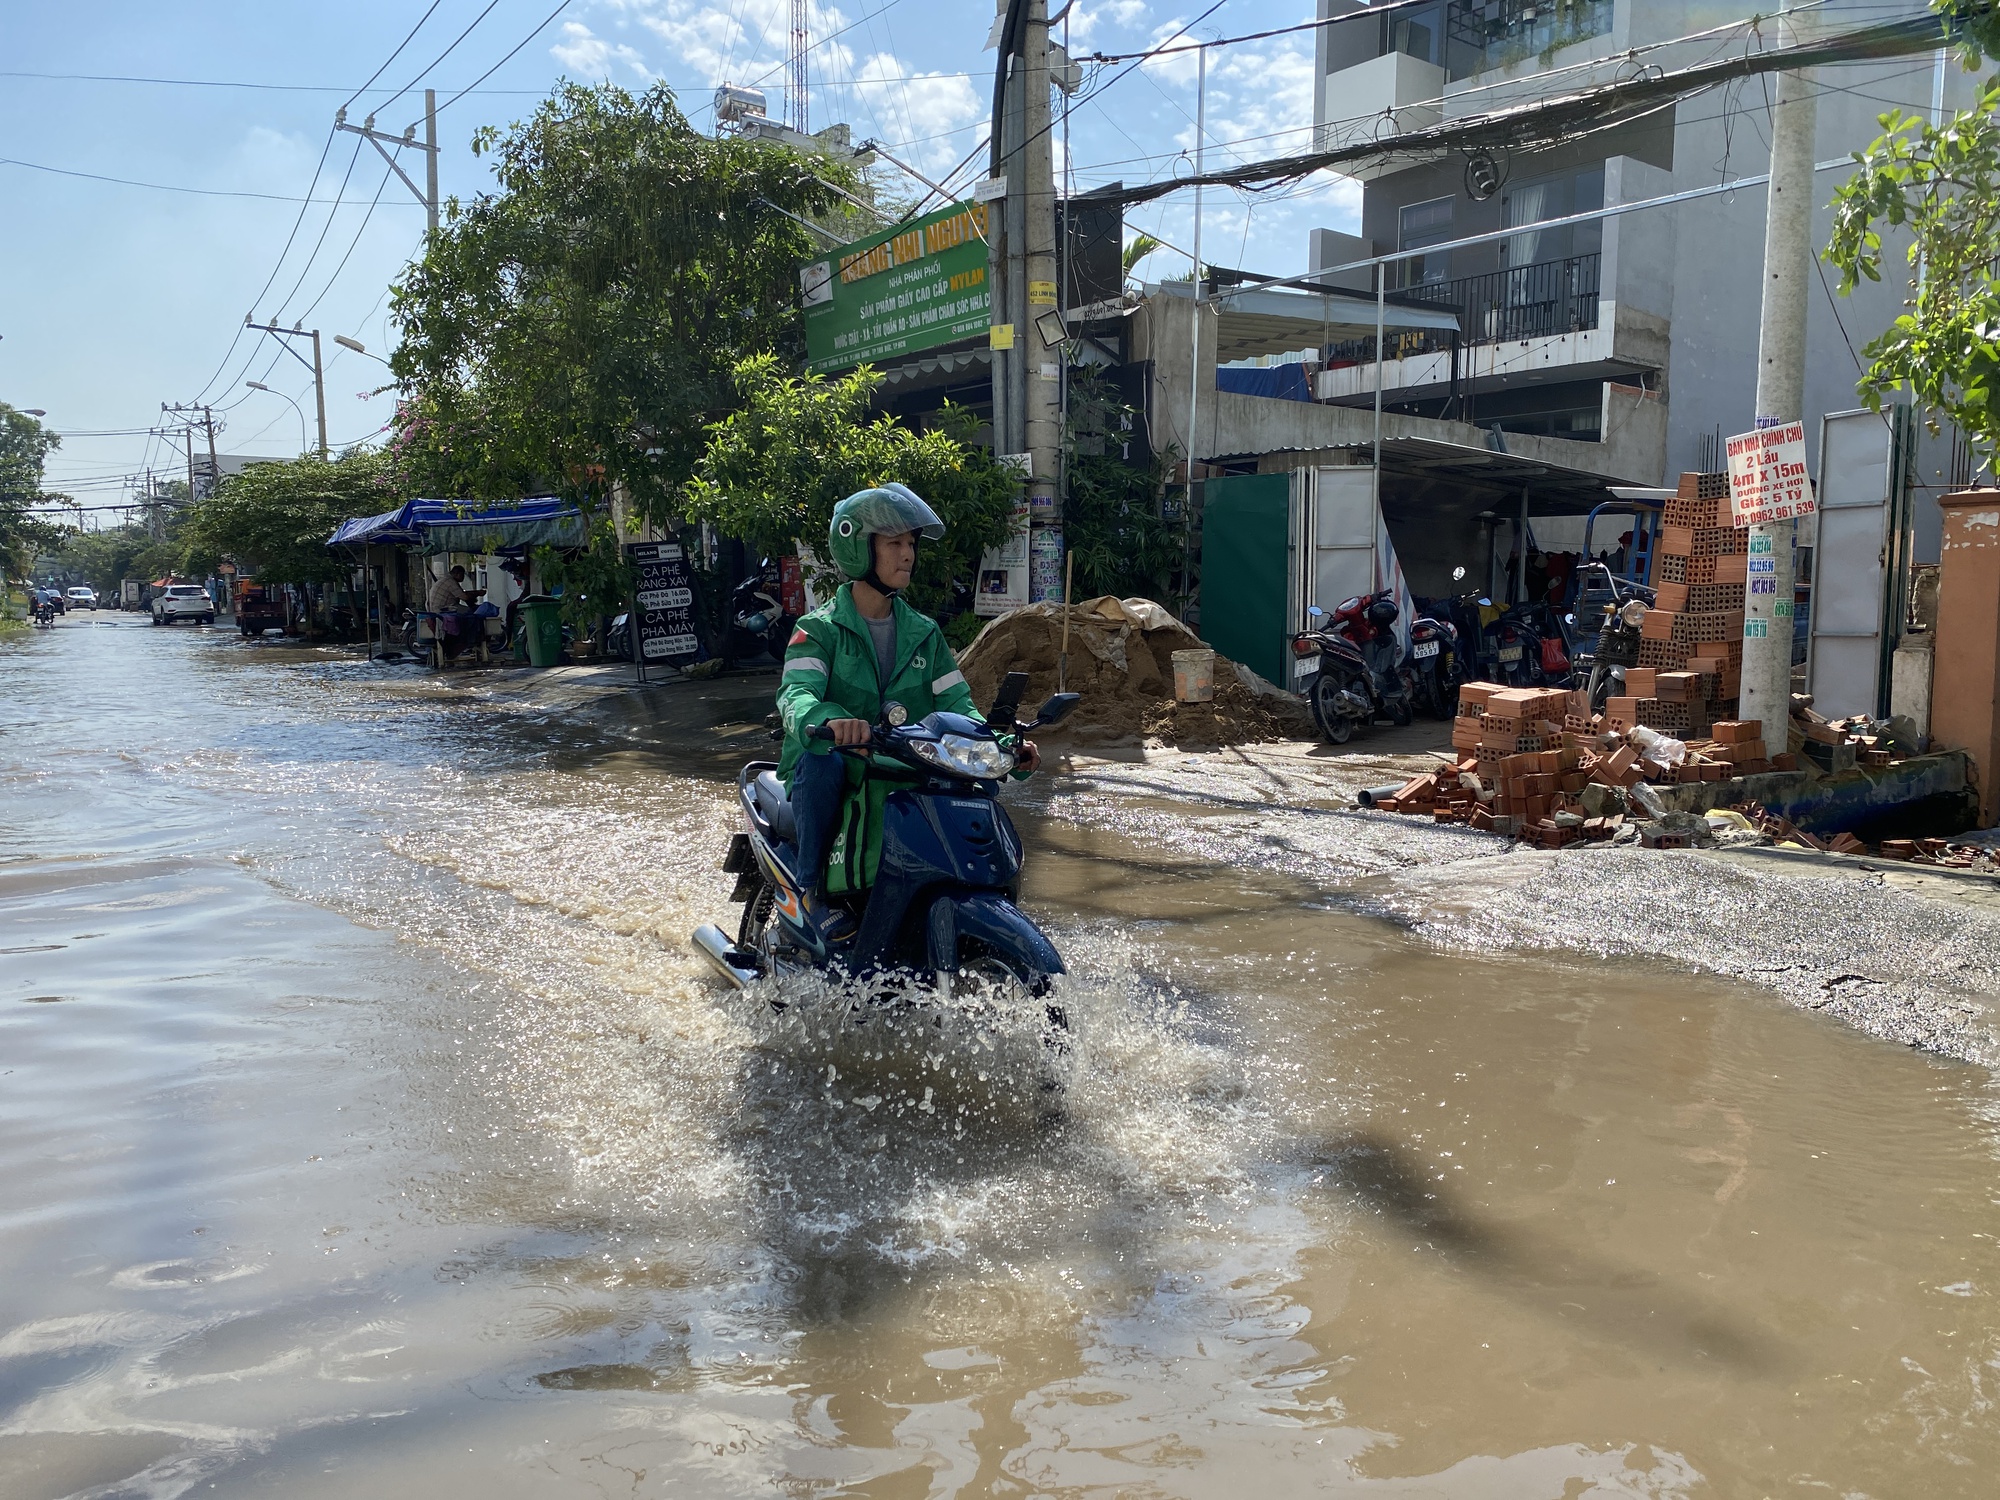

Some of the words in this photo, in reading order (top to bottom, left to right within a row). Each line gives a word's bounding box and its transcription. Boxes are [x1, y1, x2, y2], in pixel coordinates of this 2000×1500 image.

[892, 230, 923, 266] NHI
[889, 272, 902, 288] NHÀ
[904, 267, 923, 284] PHÂN
[924, 260, 941, 278] PHỐI
[861, 300, 874, 319] SẢN
[876, 293, 897, 315] PHẨM
[897, 288, 914, 309] GIẤY
[915, 285, 931, 302] CAO
[933, 276, 949, 297] CẤP
[950, 267, 985, 292] MYLAN
[908, 310, 920, 329] SẢN
[922, 303, 938, 325] PHẨM
[957, 296, 969, 315] SÓC
[970, 292, 983, 311] NHÀ
[1728, 438, 1744, 457] BÁN
[1744, 433, 1760, 453] NHÀ
[1761, 429, 1785, 448] CHÍNH
[1786, 421, 1803, 443] CHỦ
[1746, 456, 1754, 469] 2
[1757, 450, 1779, 466] Lầu
[1733, 473, 1755, 488] 4m
[1760, 470, 1769, 482] x
[1773, 462, 1804, 479] 15m
[1772, 481, 1785, 490] XE
[1786, 477, 1804, 487] HƠI
[1740, 495, 1769, 509] Giá:
[1772, 492, 1783, 503] 5
[1785, 487, 1802, 500] Tỷ
[1735, 513, 1748, 526] ĐT:
[1750, 508, 1774, 523] 0962
[1776, 505, 1793, 519] 961
[1796, 500, 1815, 515] 539
[643, 565, 660, 578] CÀ
[661, 563, 681, 576] PHÊ
[669, 575, 689, 587] XAY
[645, 610, 665, 624] CÀ
[667, 607, 690, 621] PHÊ
[641, 625, 667, 638] PHA
[669, 620, 695, 635] MÁY
[952, 800, 990, 810] HONDA
